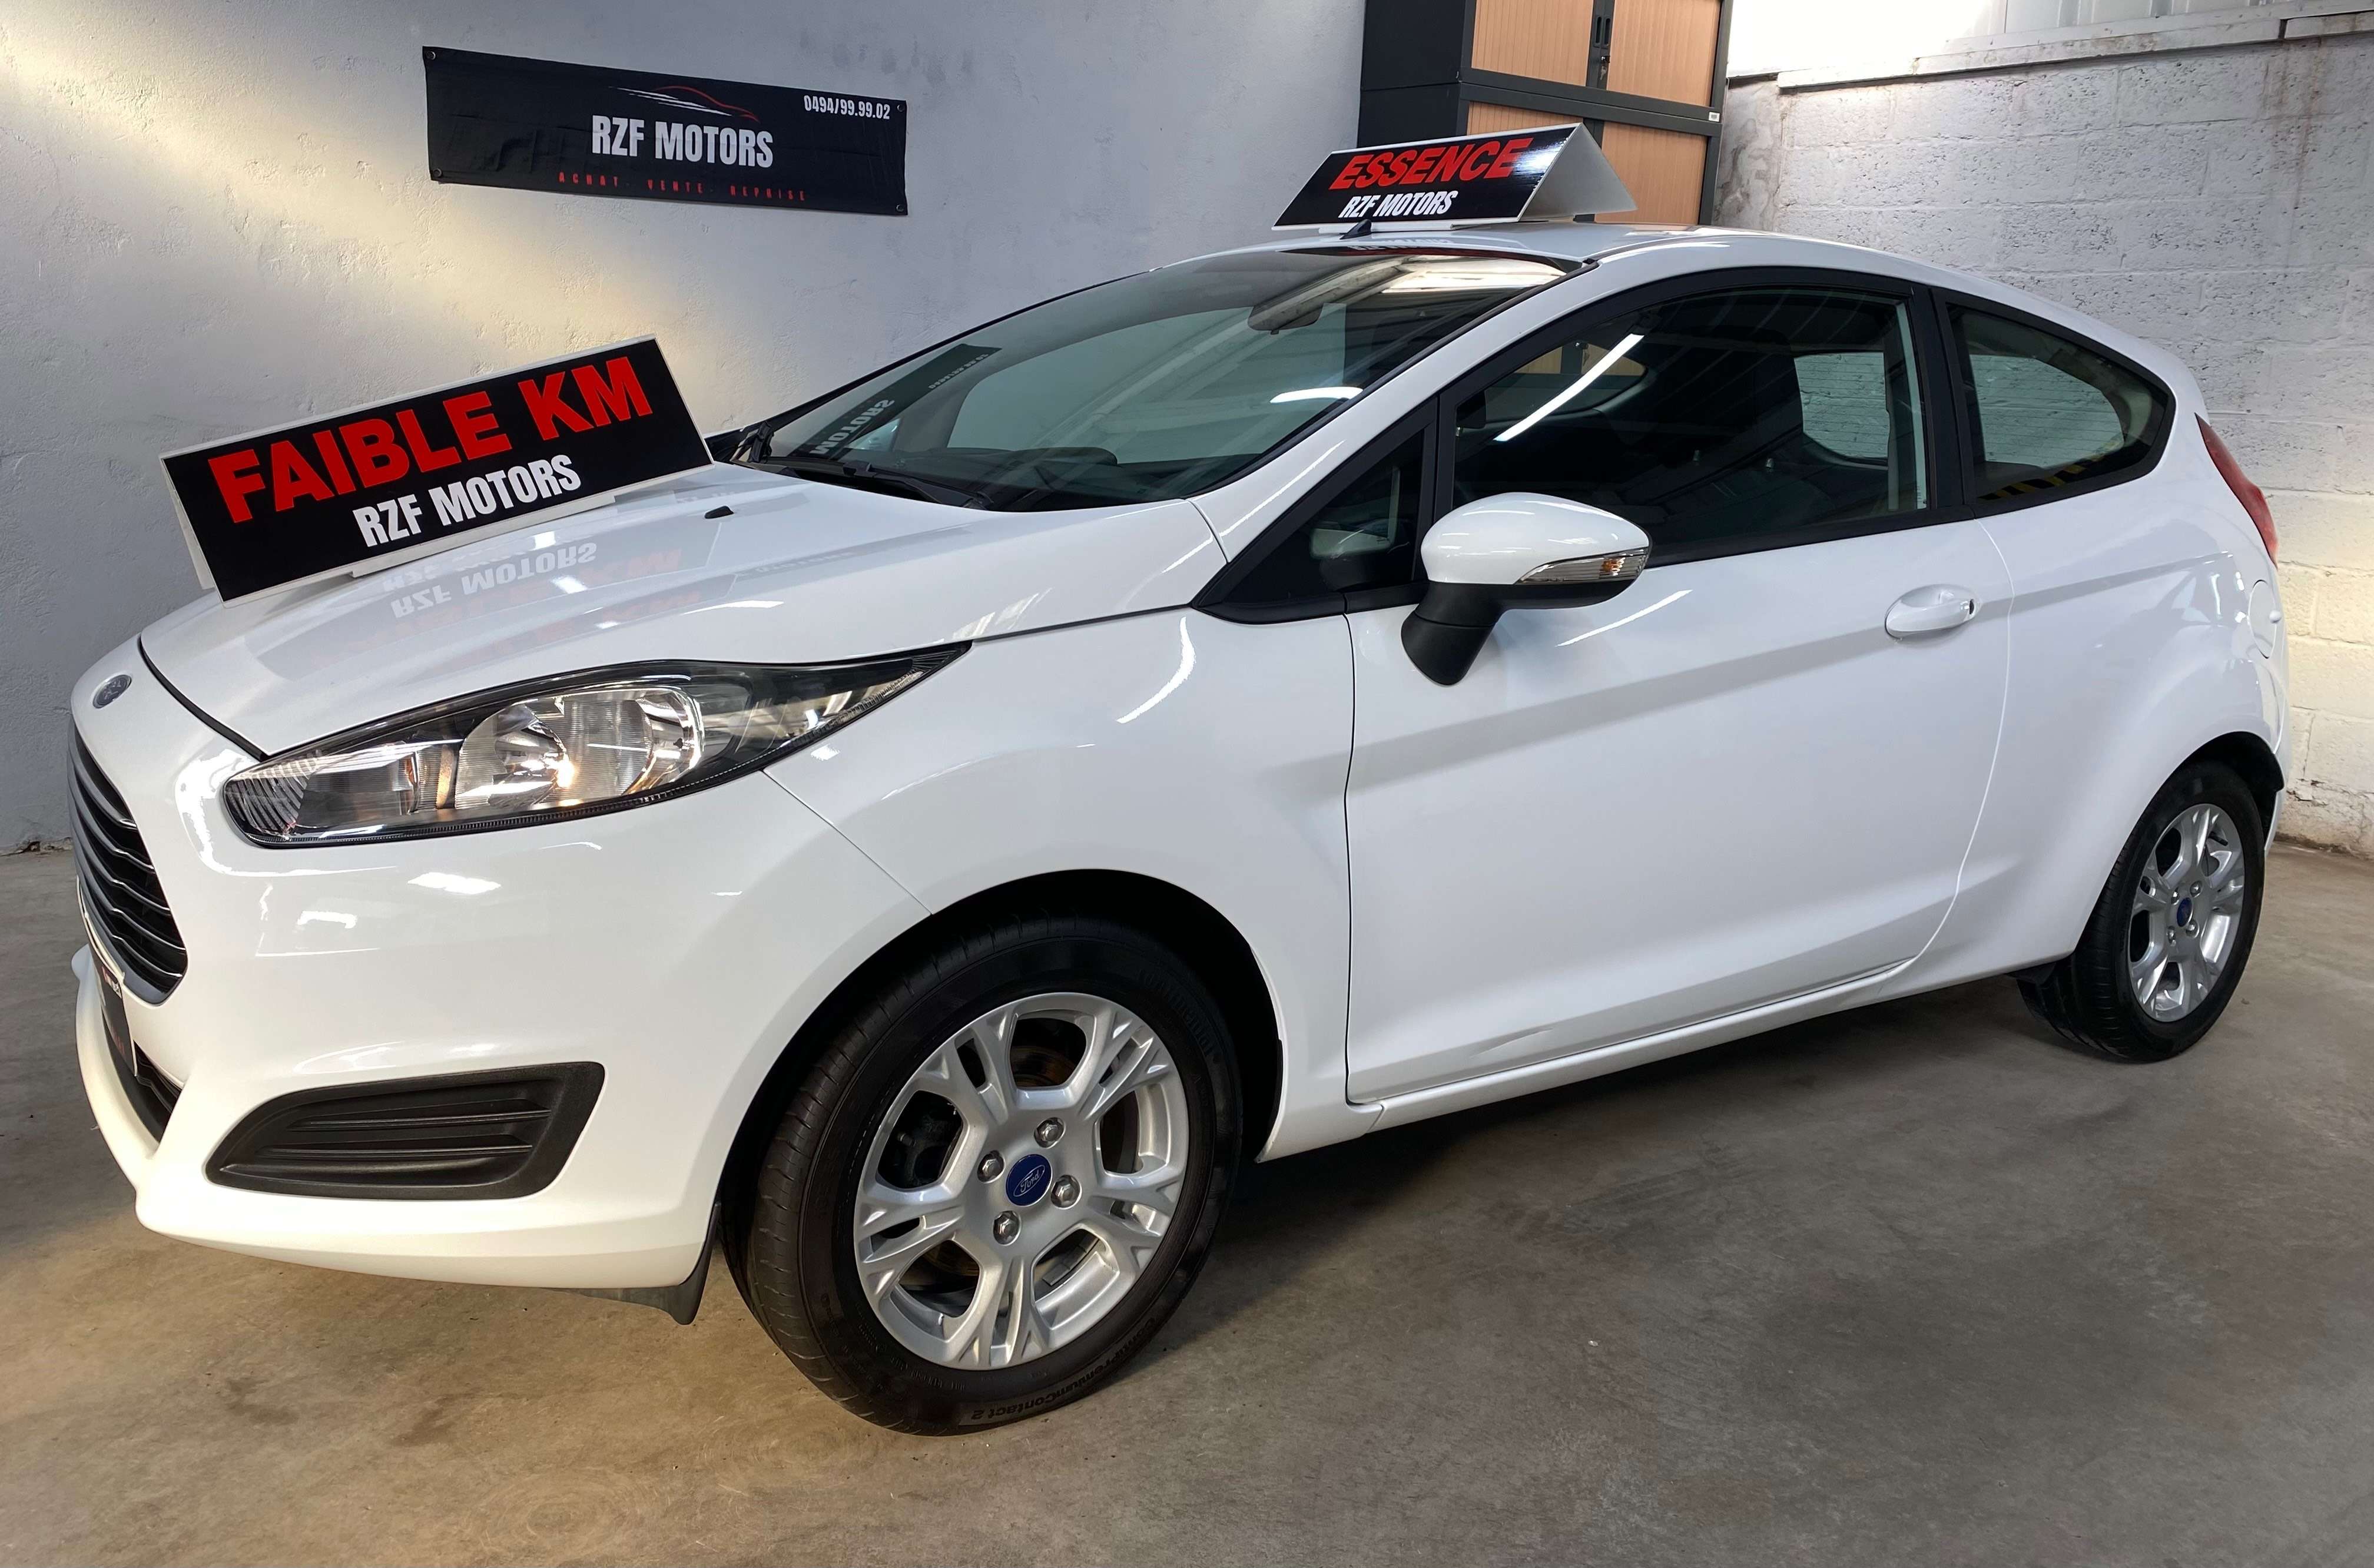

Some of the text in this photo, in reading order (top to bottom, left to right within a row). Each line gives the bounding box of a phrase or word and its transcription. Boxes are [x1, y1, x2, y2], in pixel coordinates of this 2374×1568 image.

[804, 95, 890, 120] 0494/99.99.02
[592, 115, 774, 168] RZF MOTORS
[1328, 137, 1534, 190] ESSENCE
[558, 171, 805, 201] ACHAT VENTE REPRISE
[1338, 191, 1458, 218] RZF MOTORS
[208, 356, 653, 523] FAIBLE KM
[352, 455, 581, 548] RZF MOTORS
[972, 1410, 984, 1420] 2
